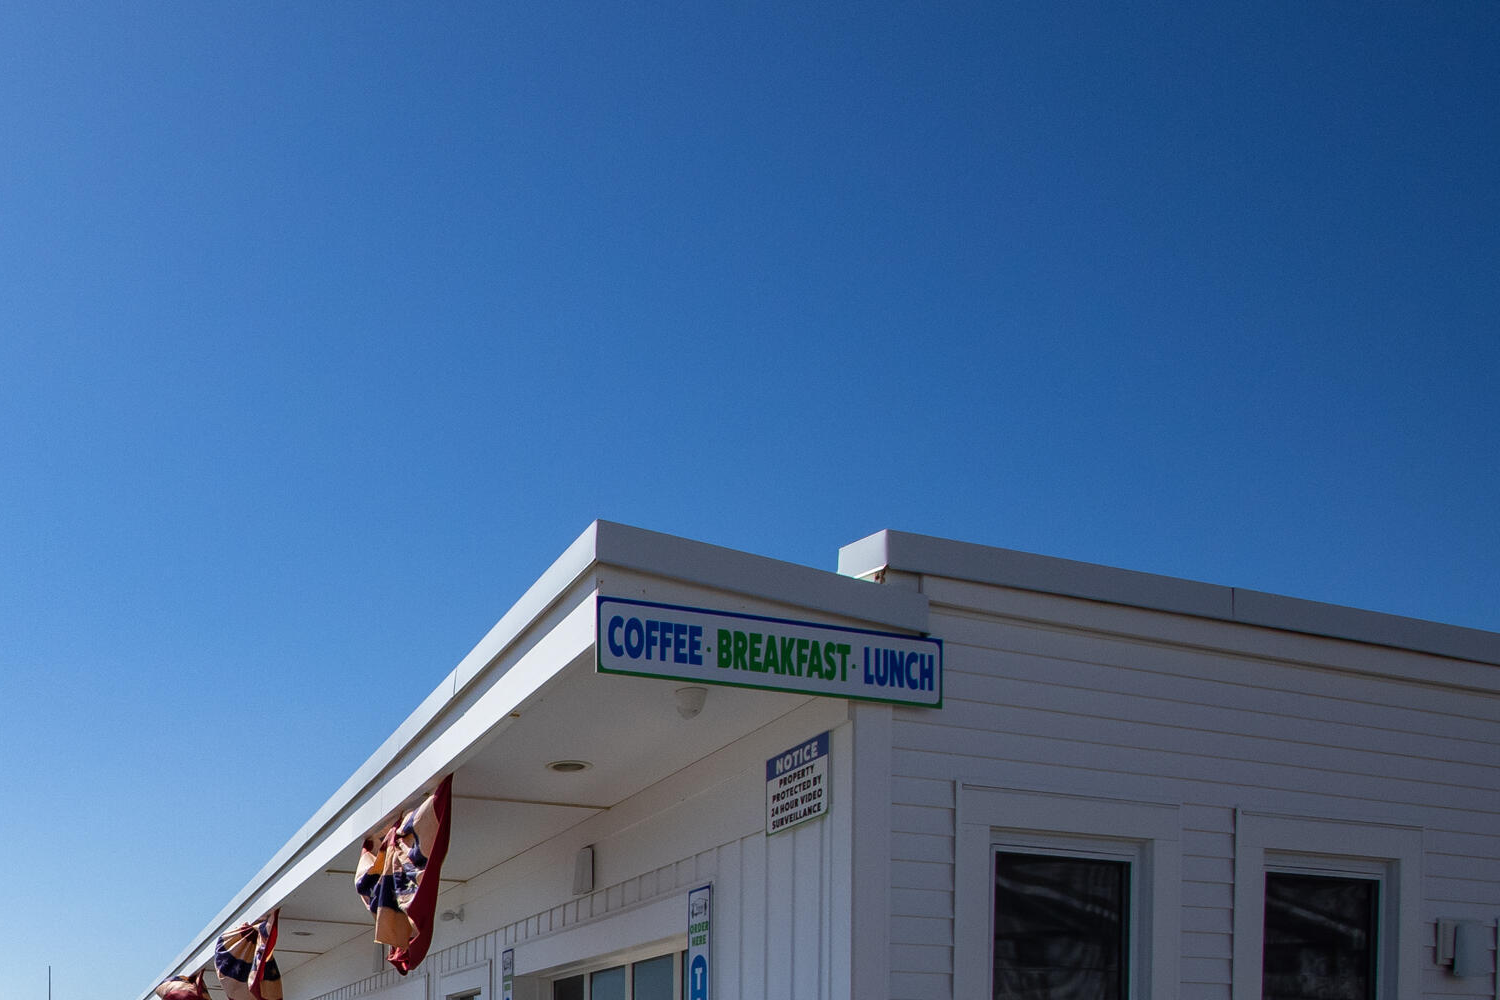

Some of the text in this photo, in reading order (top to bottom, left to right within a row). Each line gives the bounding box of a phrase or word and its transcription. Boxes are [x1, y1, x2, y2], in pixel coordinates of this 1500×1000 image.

[608, 615, 934, 691] COFFEE BREAKFAST LUNCH
[775, 741, 818, 775] NOTICE
[772, 774, 822, 804] PROTECTED BY
[779, 764, 815, 788] PROPERTY
[771, 788, 823, 818] 24 HOUR VIDEO
[771, 802, 822, 831] SURVEILLANCE
[690, 920, 709, 935] ORDER
[691, 934, 706, 947] HERE
